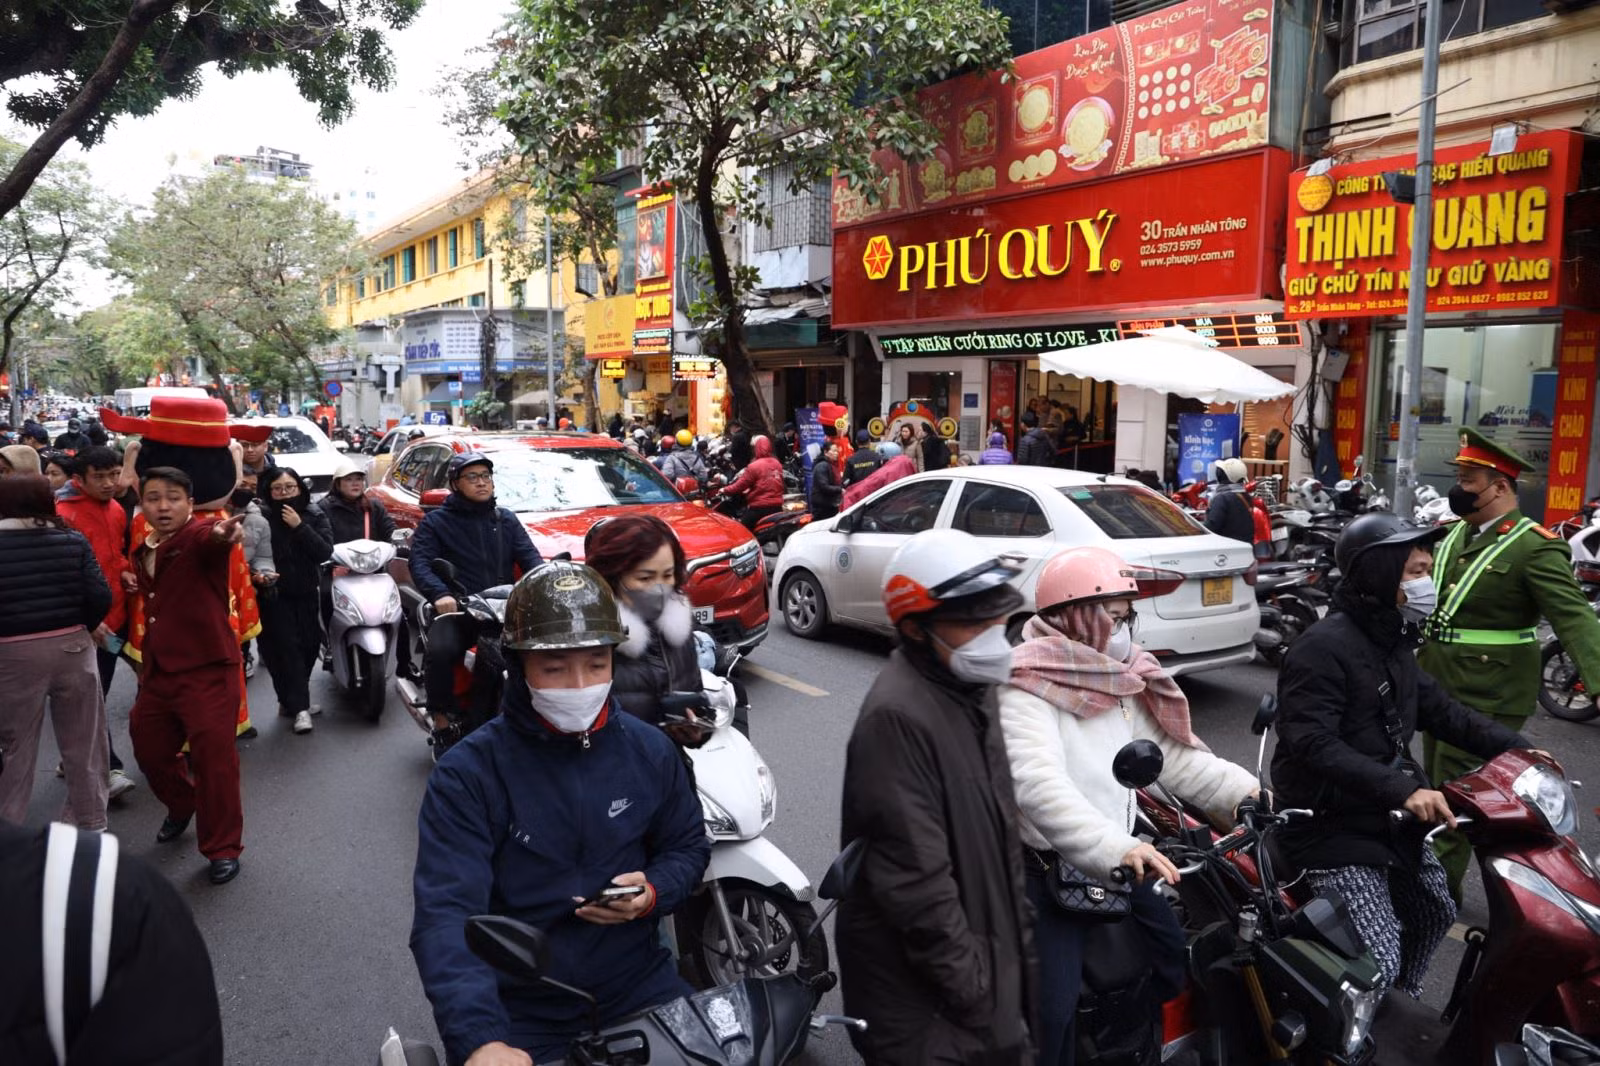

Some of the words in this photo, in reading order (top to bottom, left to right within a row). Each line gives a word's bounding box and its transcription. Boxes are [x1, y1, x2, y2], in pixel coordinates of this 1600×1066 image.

[1336, 175, 1369, 196] CÔNG
[1497, 149, 1549, 173] QUANG
[1140, 219, 1162, 241] 30
[1190, 220, 1218, 236] NHÂN
[1219, 217, 1247, 232] TÔNG
[1295, 206, 1397, 270] THỊNH
[1407, 185, 1547, 251] UANG
[898, 228, 992, 292] PHÚ
[998, 209, 1118, 280] QUÝ
[1140, 244, 1156, 256] 024
[1157, 241, 1179, 254] 3573
[1179, 238, 1203, 251] 5959
[1140, 249, 1235, 268] www.phuquy.com.vn
[1364, 267, 1394, 292] TÍN
[1399, 267, 1443, 290] NƯ
[1493, 256, 1551, 282] VÀNG
[989, 333, 1022, 349] RING
[1024, 331, 1044, 348] OF
[1045, 330, 1088, 348] LOVE
[1559, 410, 1585, 438] CHÀO
[1558, 447, 1579, 475] QUÝ
[1548, 482, 1581, 511] KHÁCH
[610, 797, 630, 809] NIKE
